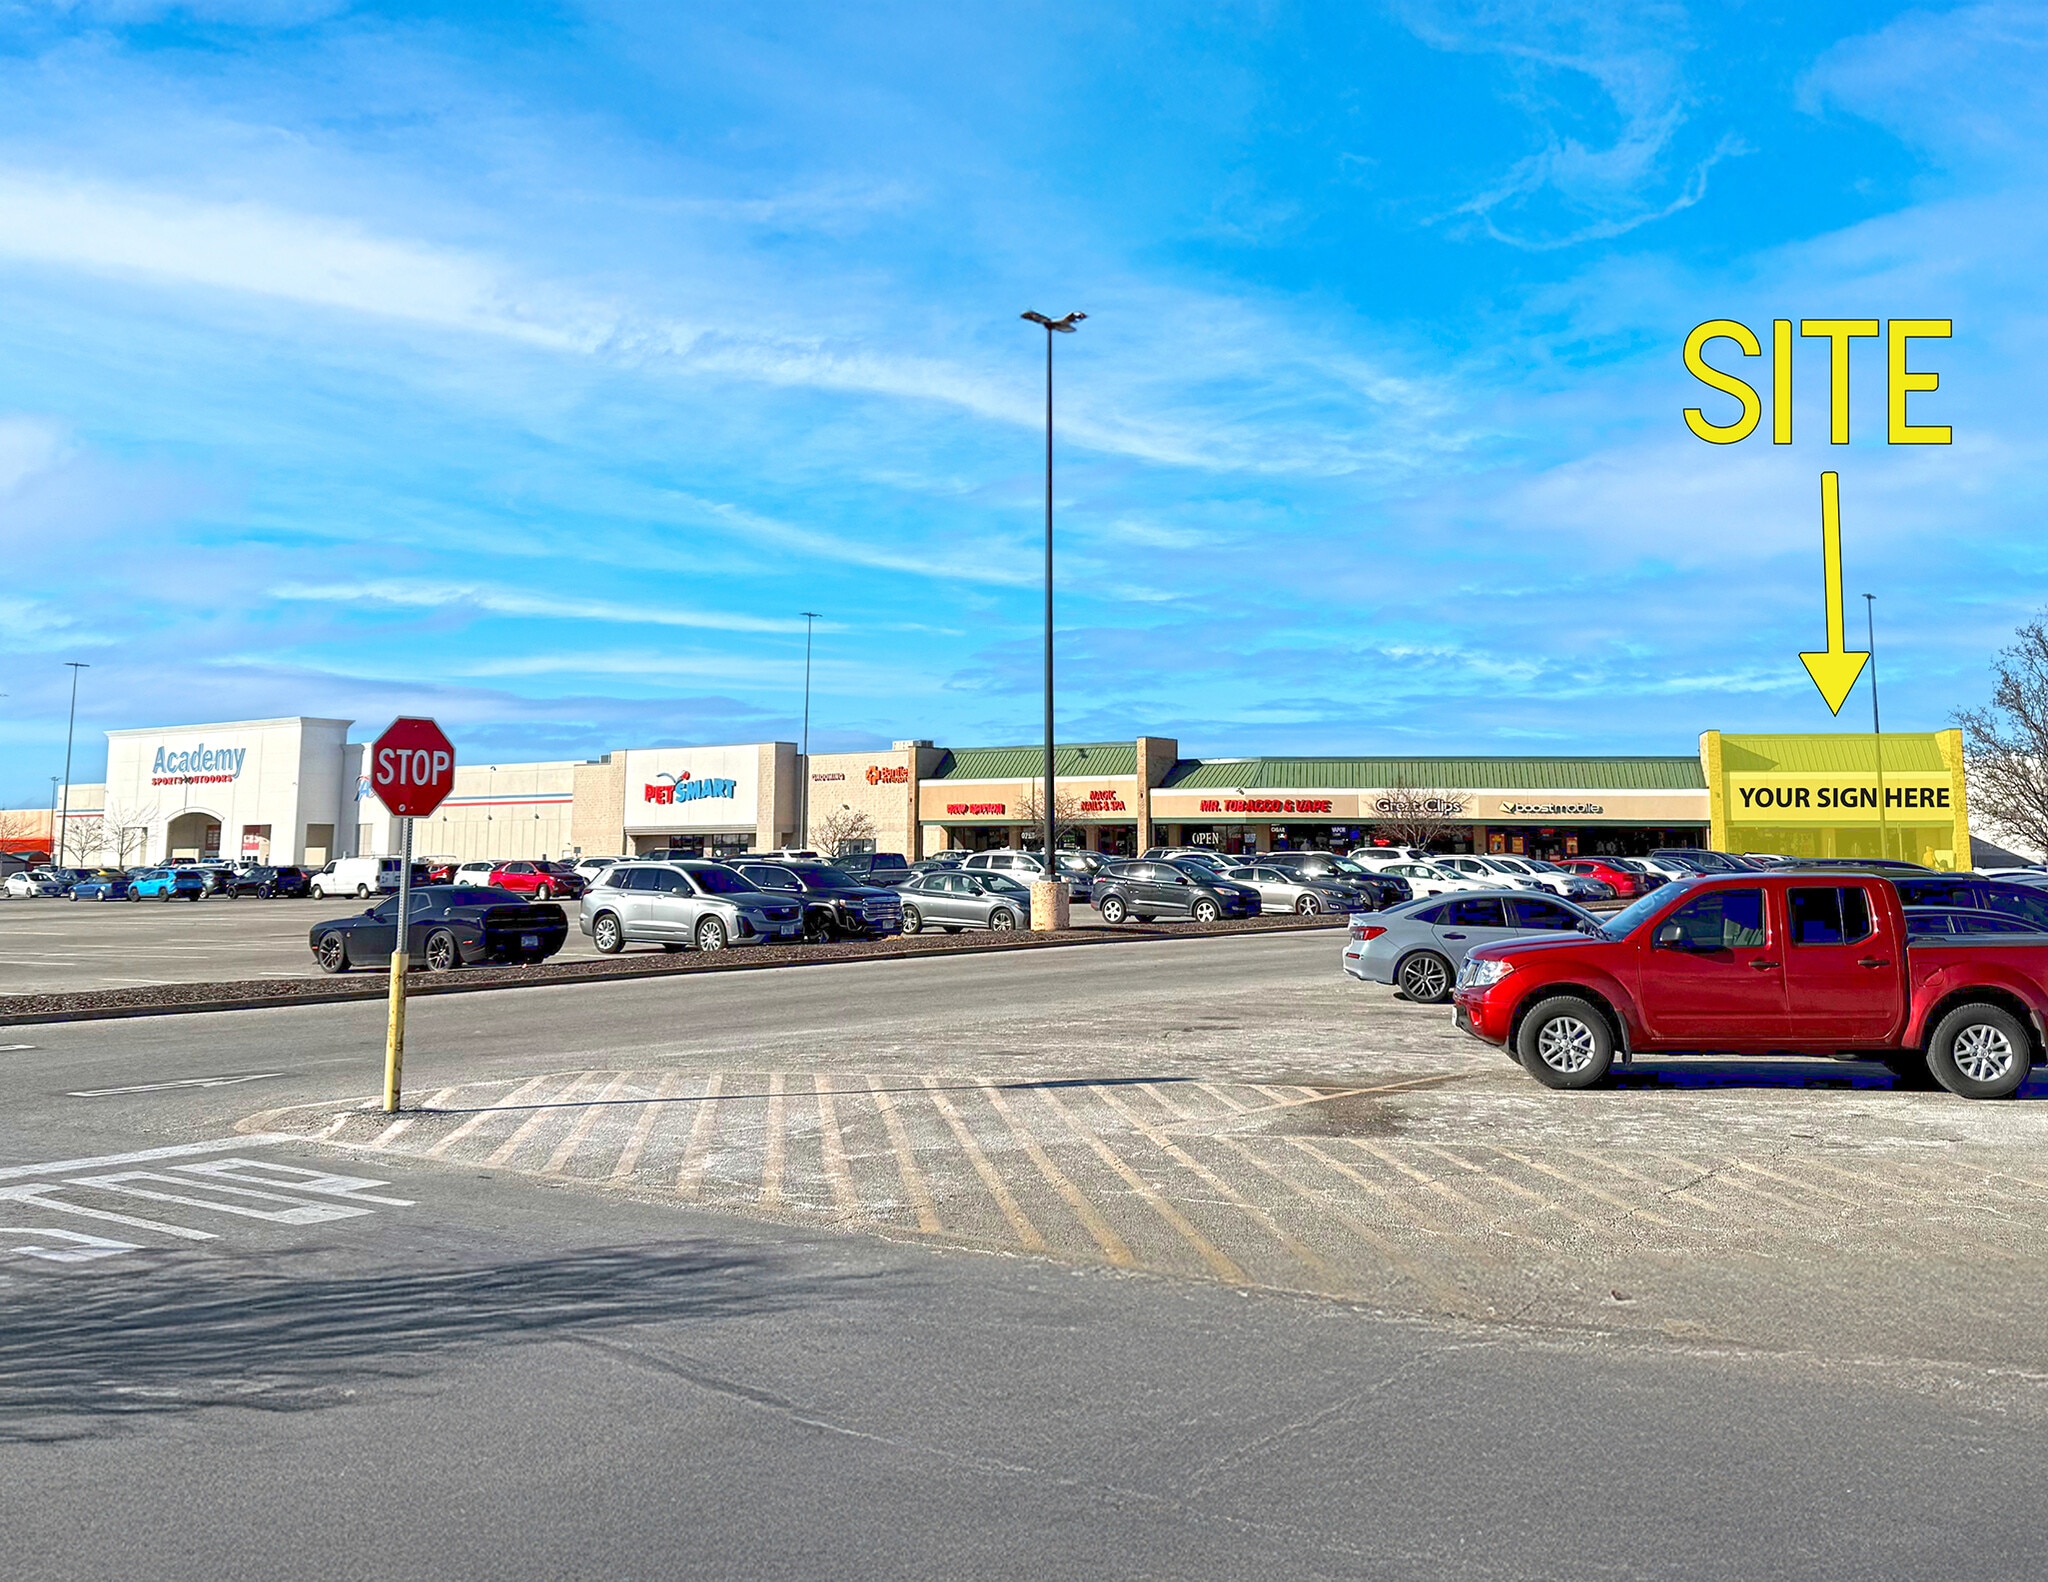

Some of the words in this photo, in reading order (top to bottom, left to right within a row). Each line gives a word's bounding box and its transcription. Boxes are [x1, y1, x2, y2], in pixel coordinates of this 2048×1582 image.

[152, 743, 246, 779] Academy
[377, 748, 450, 785] STOP
[189, 774, 233, 785] OUTDOORS
[1089, 790, 1117, 801] MAGIC
[1080, 801, 1102, 812] NAILS
[1110, 801, 1126, 812] SPA
[1200, 799, 1222, 812] MR.
[1224, 799, 1283, 813] TOBACCO
[1295, 799, 1333, 813] VAPE
[1424, 798, 1462, 815] Clips
[1191, 832, 1220, 844] OPEN
